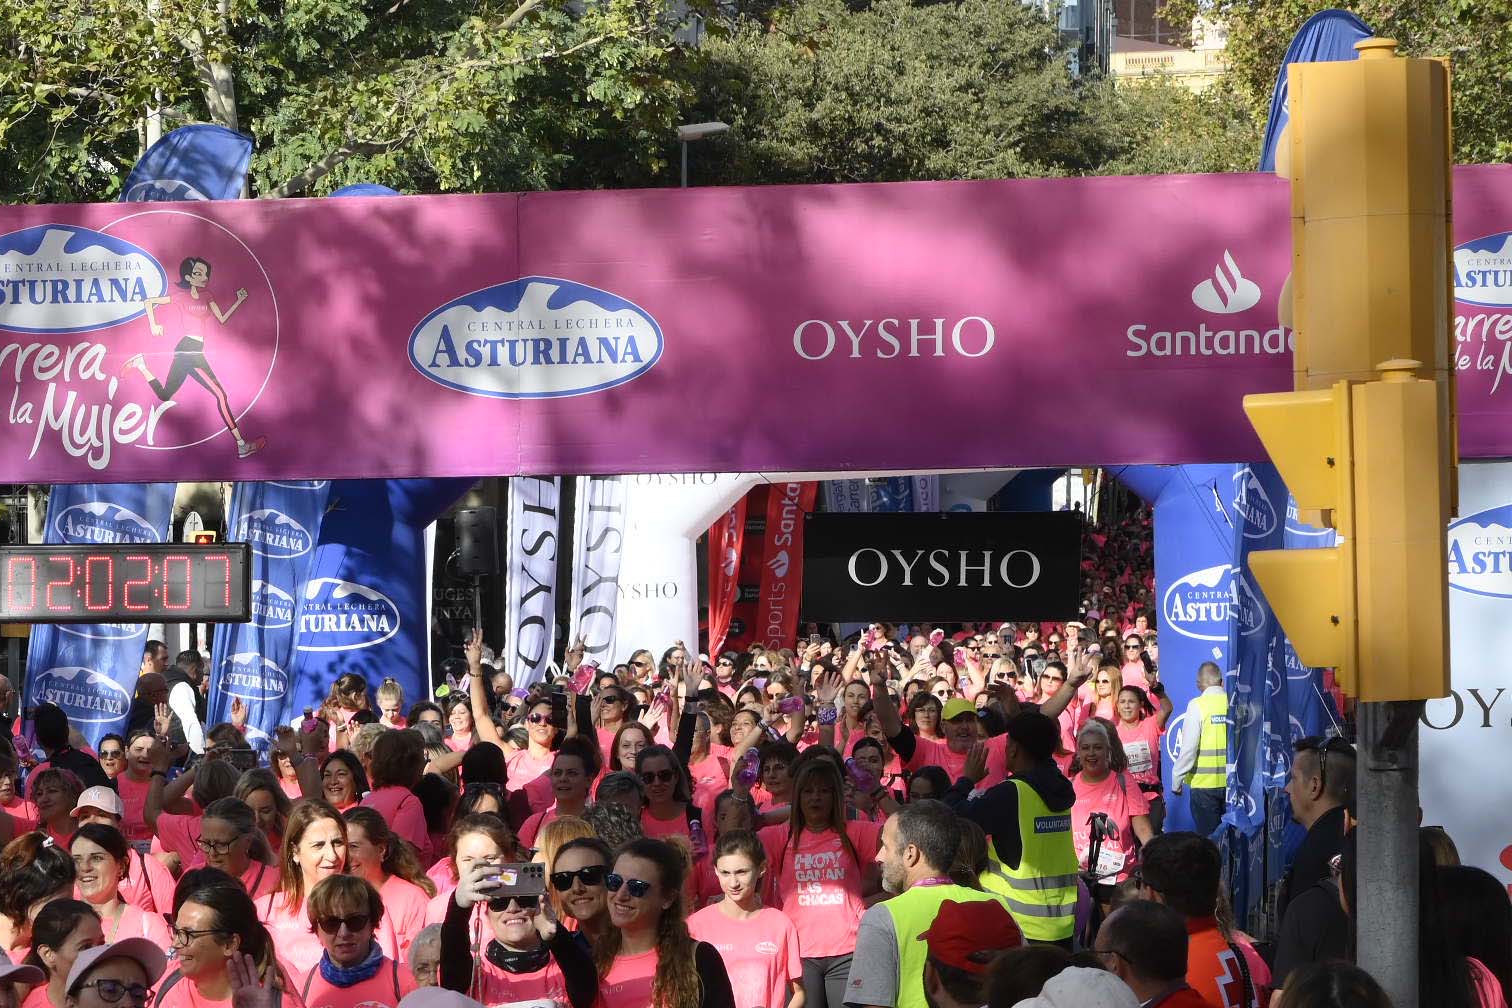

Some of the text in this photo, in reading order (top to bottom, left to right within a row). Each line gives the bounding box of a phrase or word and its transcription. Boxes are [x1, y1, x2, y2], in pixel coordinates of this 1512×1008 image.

[71, 261, 142, 272] LECHERA
[468, 317, 634, 332] CENTRAL LECHERA
[793, 316, 995, 360] OYSHO
[1126, 323, 1296, 358] Santand
[428, 324, 643, 369] ASTURIANA
[1476, 342, 1495, 371] la
[9, 387, 33, 424] la
[28, 376, 178, 470] Mujer
[8, 555, 230, 611] 02:02:07
[847, 547, 1040, 588] OYSHO
